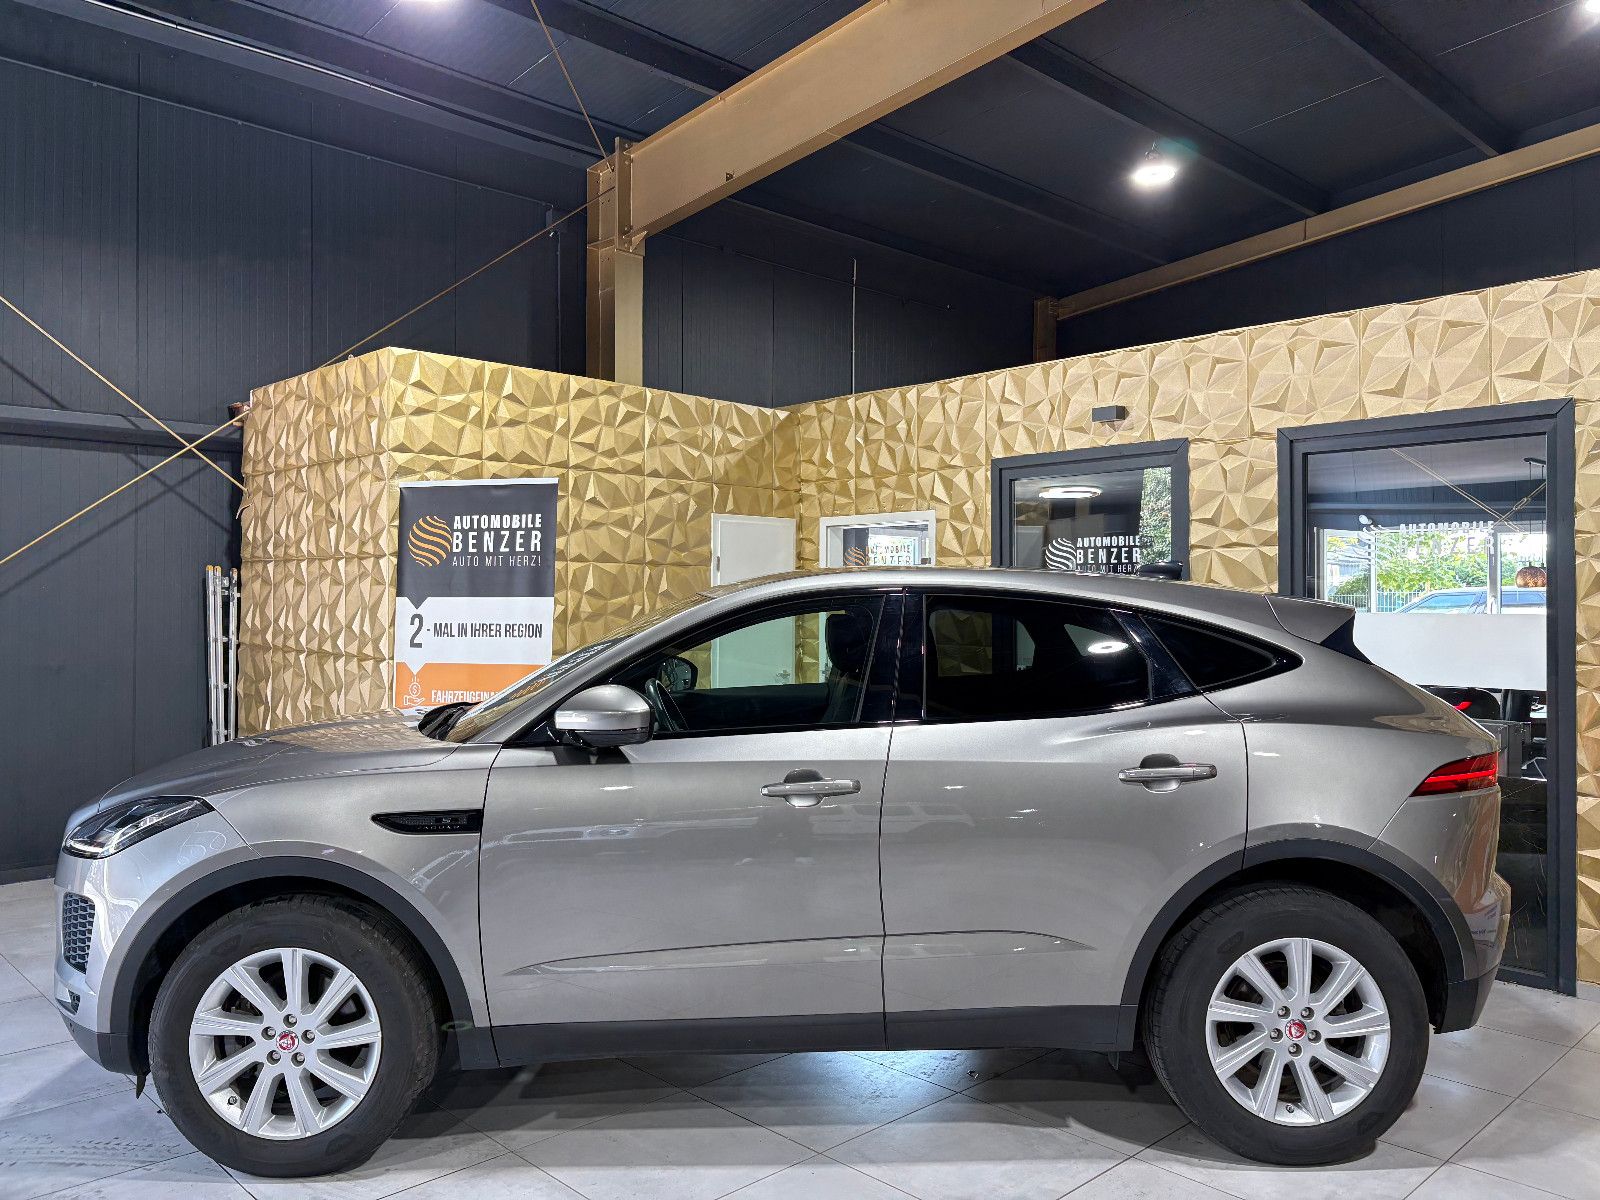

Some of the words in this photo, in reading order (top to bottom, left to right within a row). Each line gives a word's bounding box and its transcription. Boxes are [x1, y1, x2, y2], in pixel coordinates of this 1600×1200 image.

[453, 513, 542, 530] AUTOMOBILE
[1400, 520, 1494, 535] AUTOMOBILE
[452, 530, 542, 553] BENZER
[1076, 535, 1140, 548] AUTOMOBILE
[1399, 535, 1495, 556] BENZER
[452, 555, 479, 567] AUTO
[485, 555, 503, 567] MIT
[509, 555, 541, 567] HERZ!
[1076, 547, 1141, 564] BENZER
[1100, 564, 1113, 573] MIT
[1117, 564, 1139, 573] HERZ
[409, 613, 424, 648] 2
[433, 622, 455, 638] MAL
[457, 622, 468, 638] IN
[470, 622, 502, 638] IHRER
[504, 623, 543, 638] REGION
